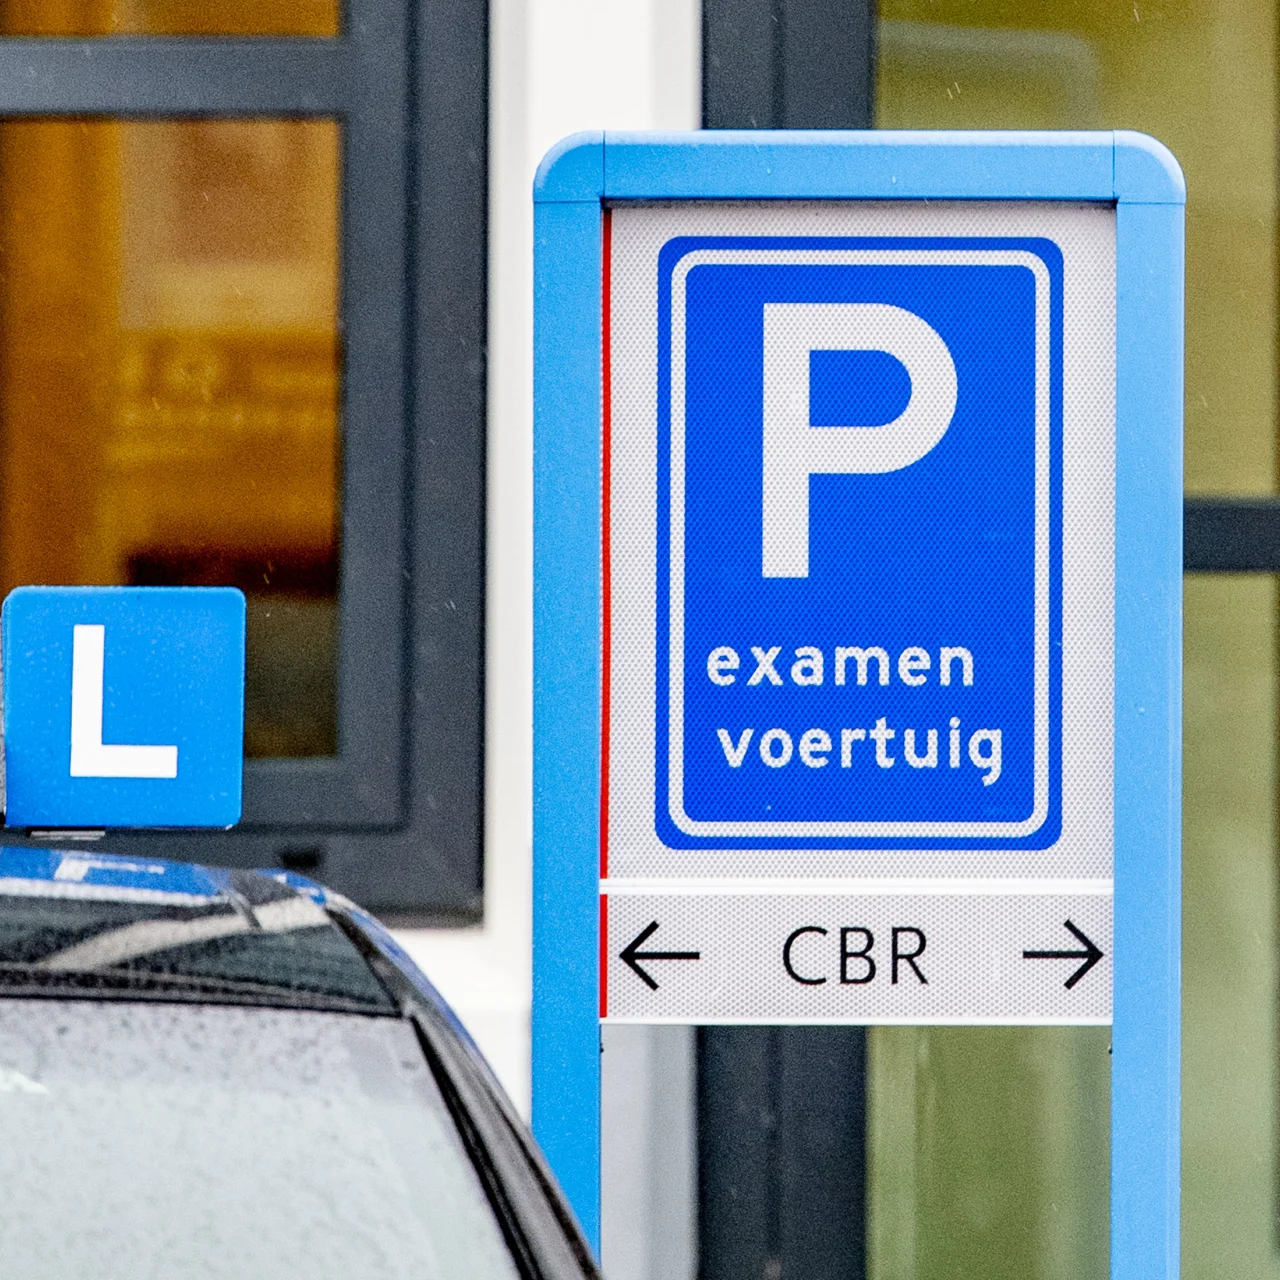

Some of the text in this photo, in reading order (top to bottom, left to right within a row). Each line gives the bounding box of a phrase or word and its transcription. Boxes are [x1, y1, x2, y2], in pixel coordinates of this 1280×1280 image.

[761, 302, 959, 578] P
[70, 624, 178, 779] L
[706, 645, 974, 688] examen
[716, 716, 1003, 787] voertuig
[782, 925, 928, 986] CBR
